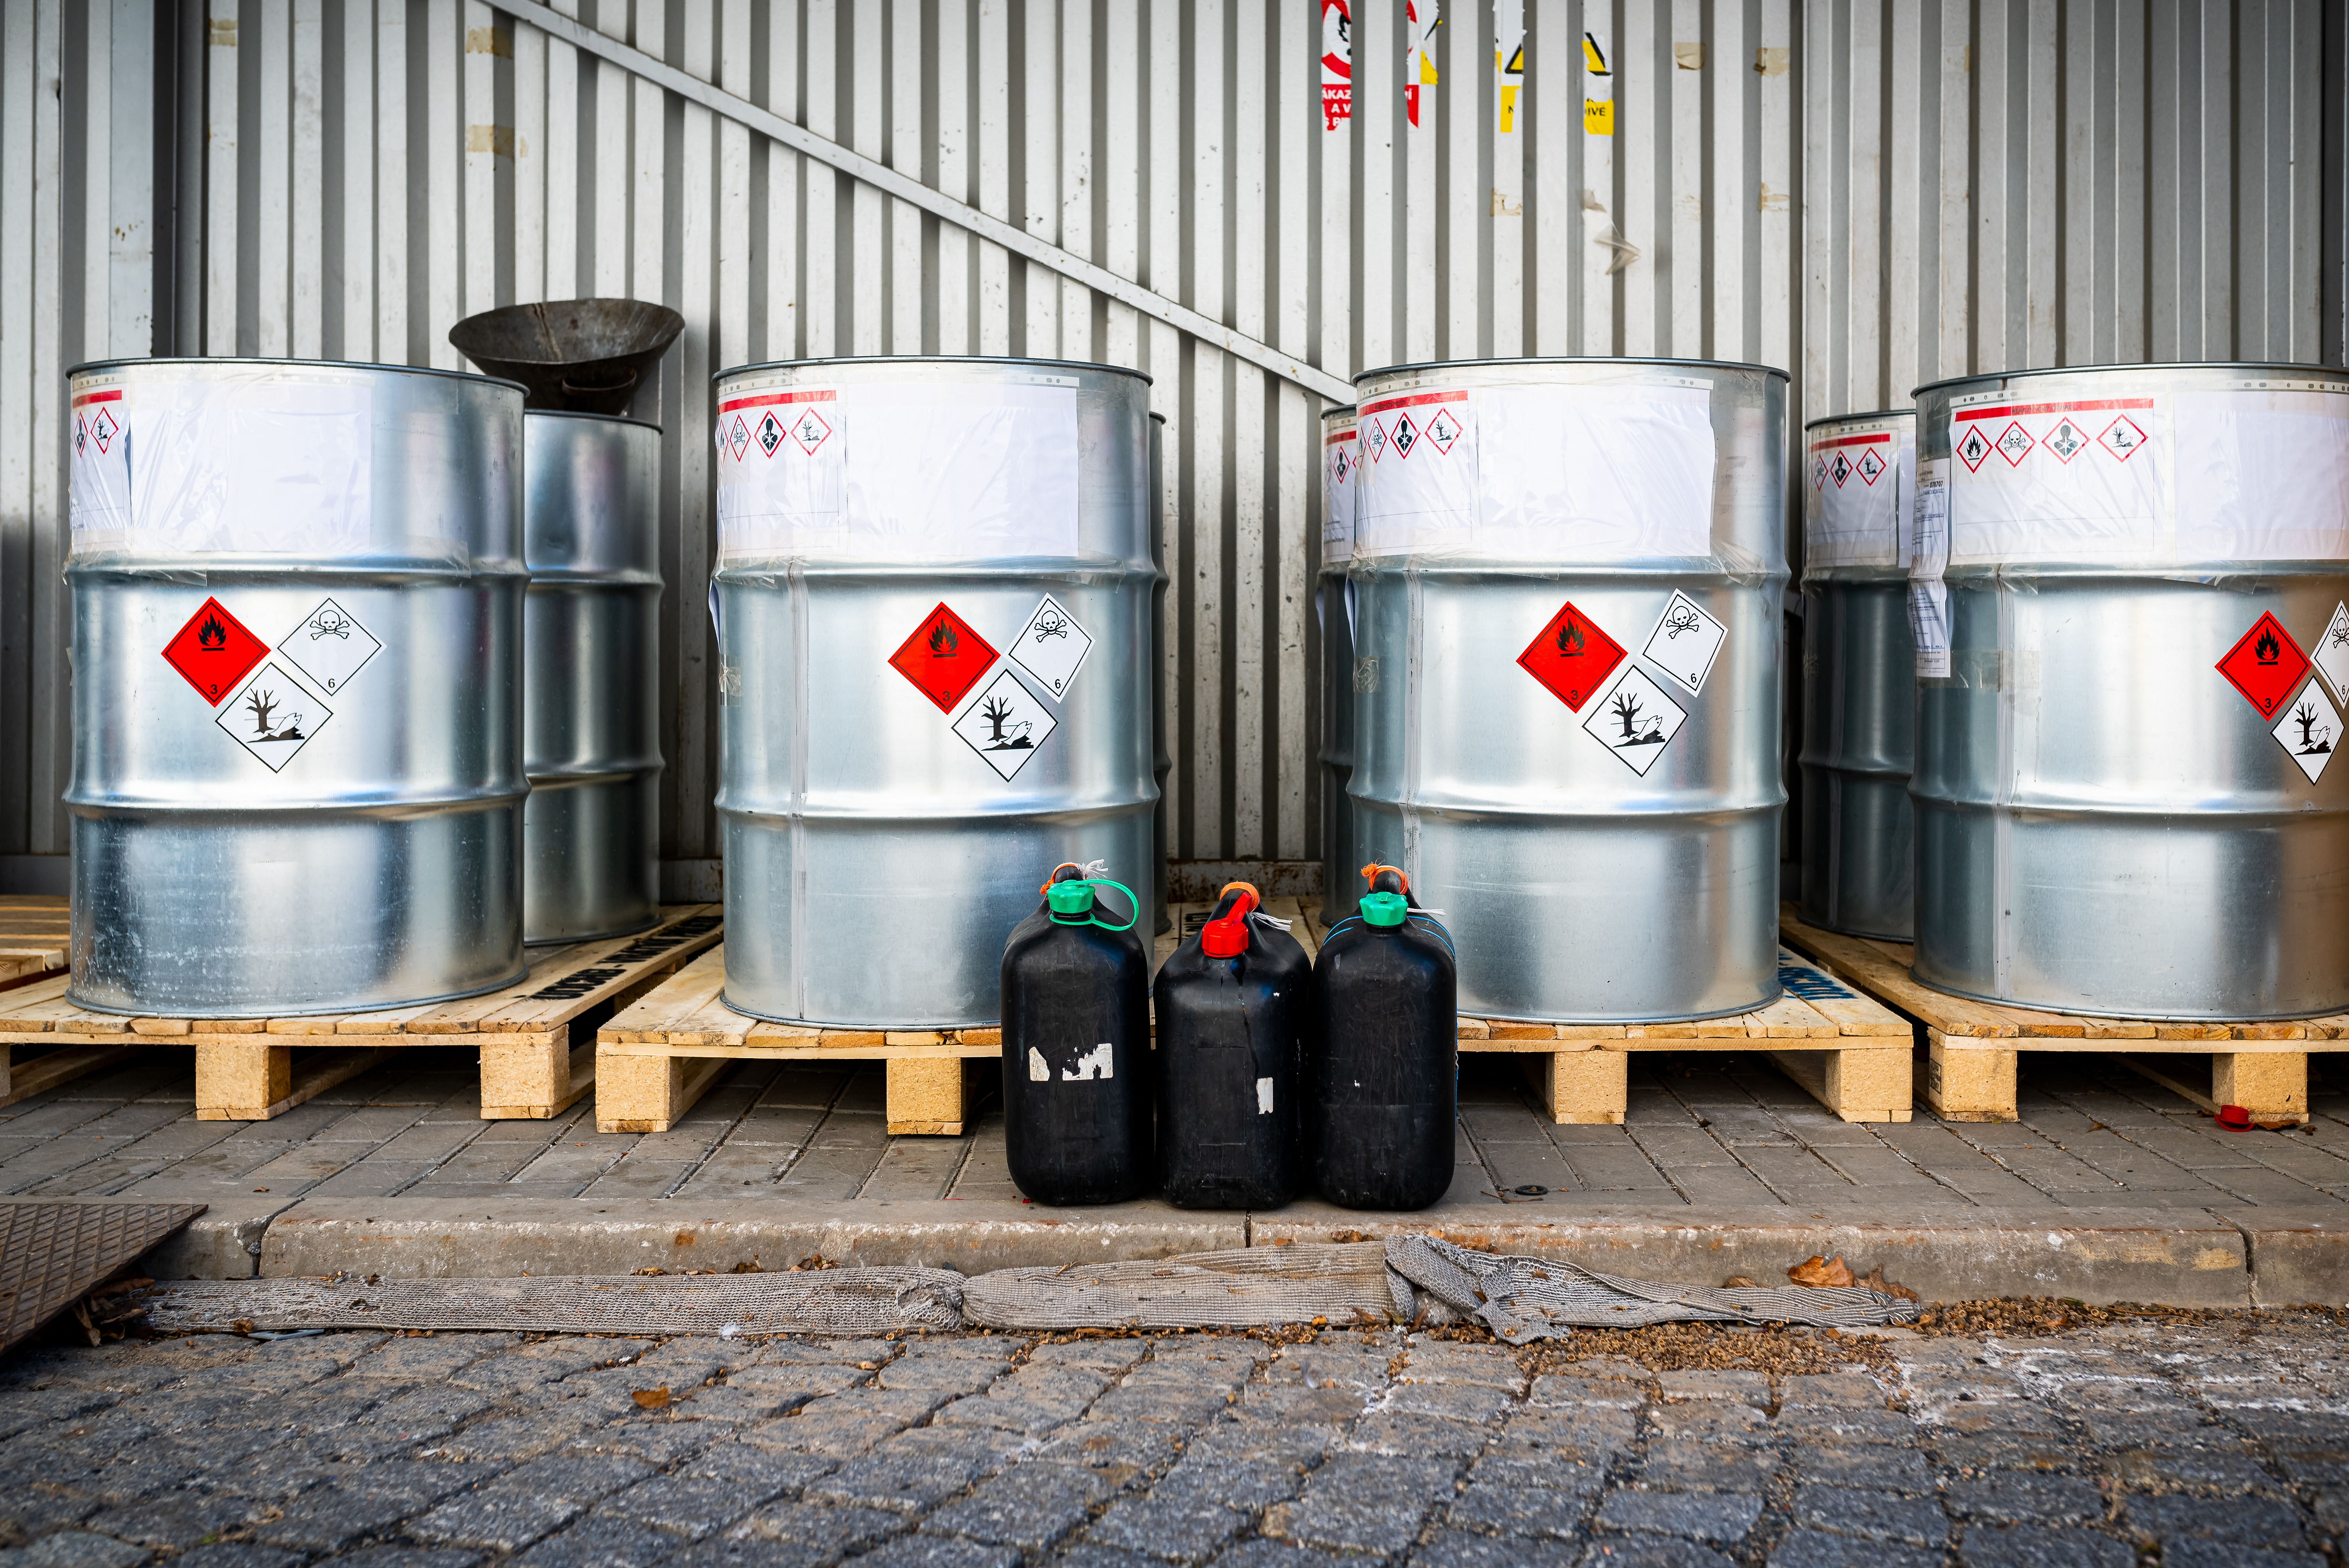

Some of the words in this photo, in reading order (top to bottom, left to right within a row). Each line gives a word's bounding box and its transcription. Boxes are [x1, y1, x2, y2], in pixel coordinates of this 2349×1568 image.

[1691, 673, 1697, 683] 6
[328, 679, 335, 688] 6
[1055, 679, 1060, 689] 6
[210, 684, 217, 694] 3
[2342, 684, 2345, 695] 6
[943, 691, 950, 701] 3
[1571, 690, 1578, 700] 3
[2265, 698, 2271, 708] 3
